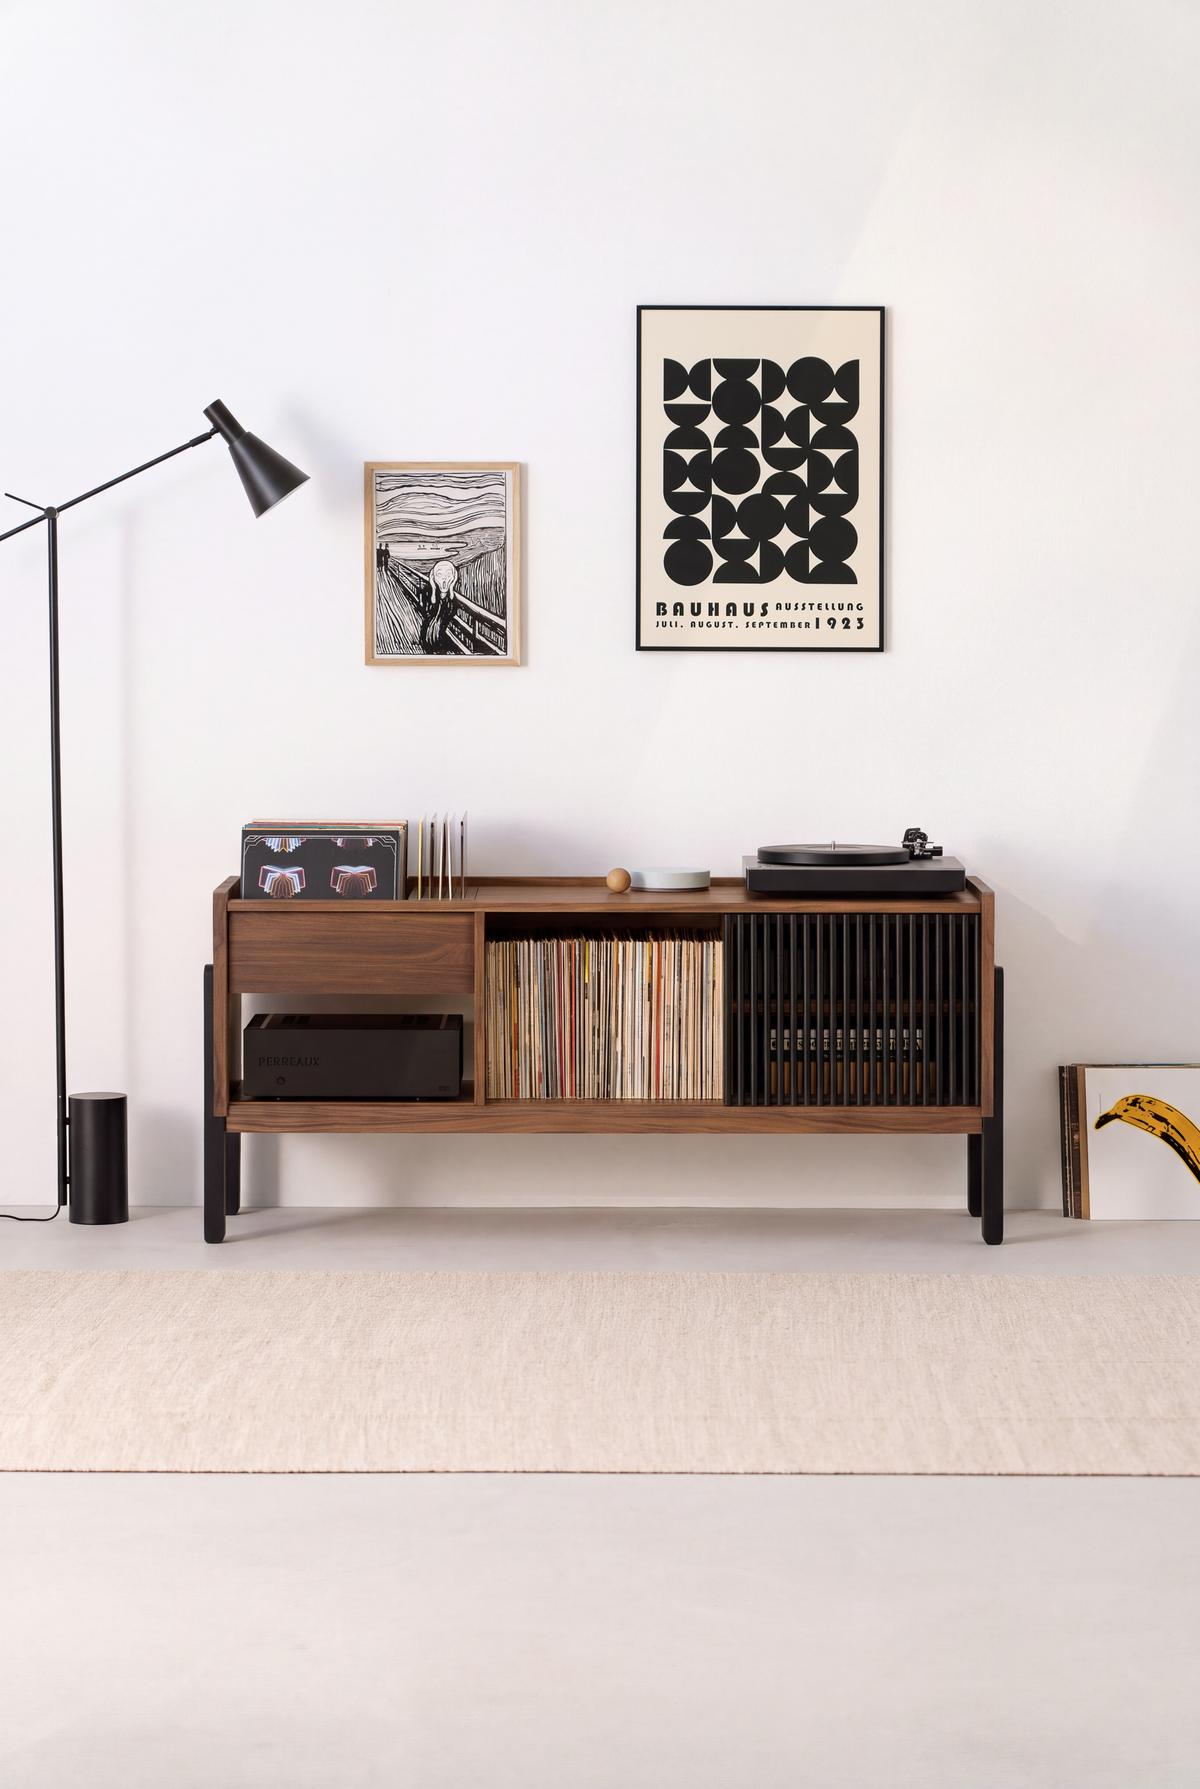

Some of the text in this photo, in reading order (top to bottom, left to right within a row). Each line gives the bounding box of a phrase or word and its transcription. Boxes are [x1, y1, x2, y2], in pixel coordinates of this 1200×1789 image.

[655, 601, 864, 618] BAUHAUS AUSSTELLUNG
[655, 616, 865, 630] JULI. AUGUST. SEPTEMBER 1923
[258, 1057, 320, 1066] PERREAUX
